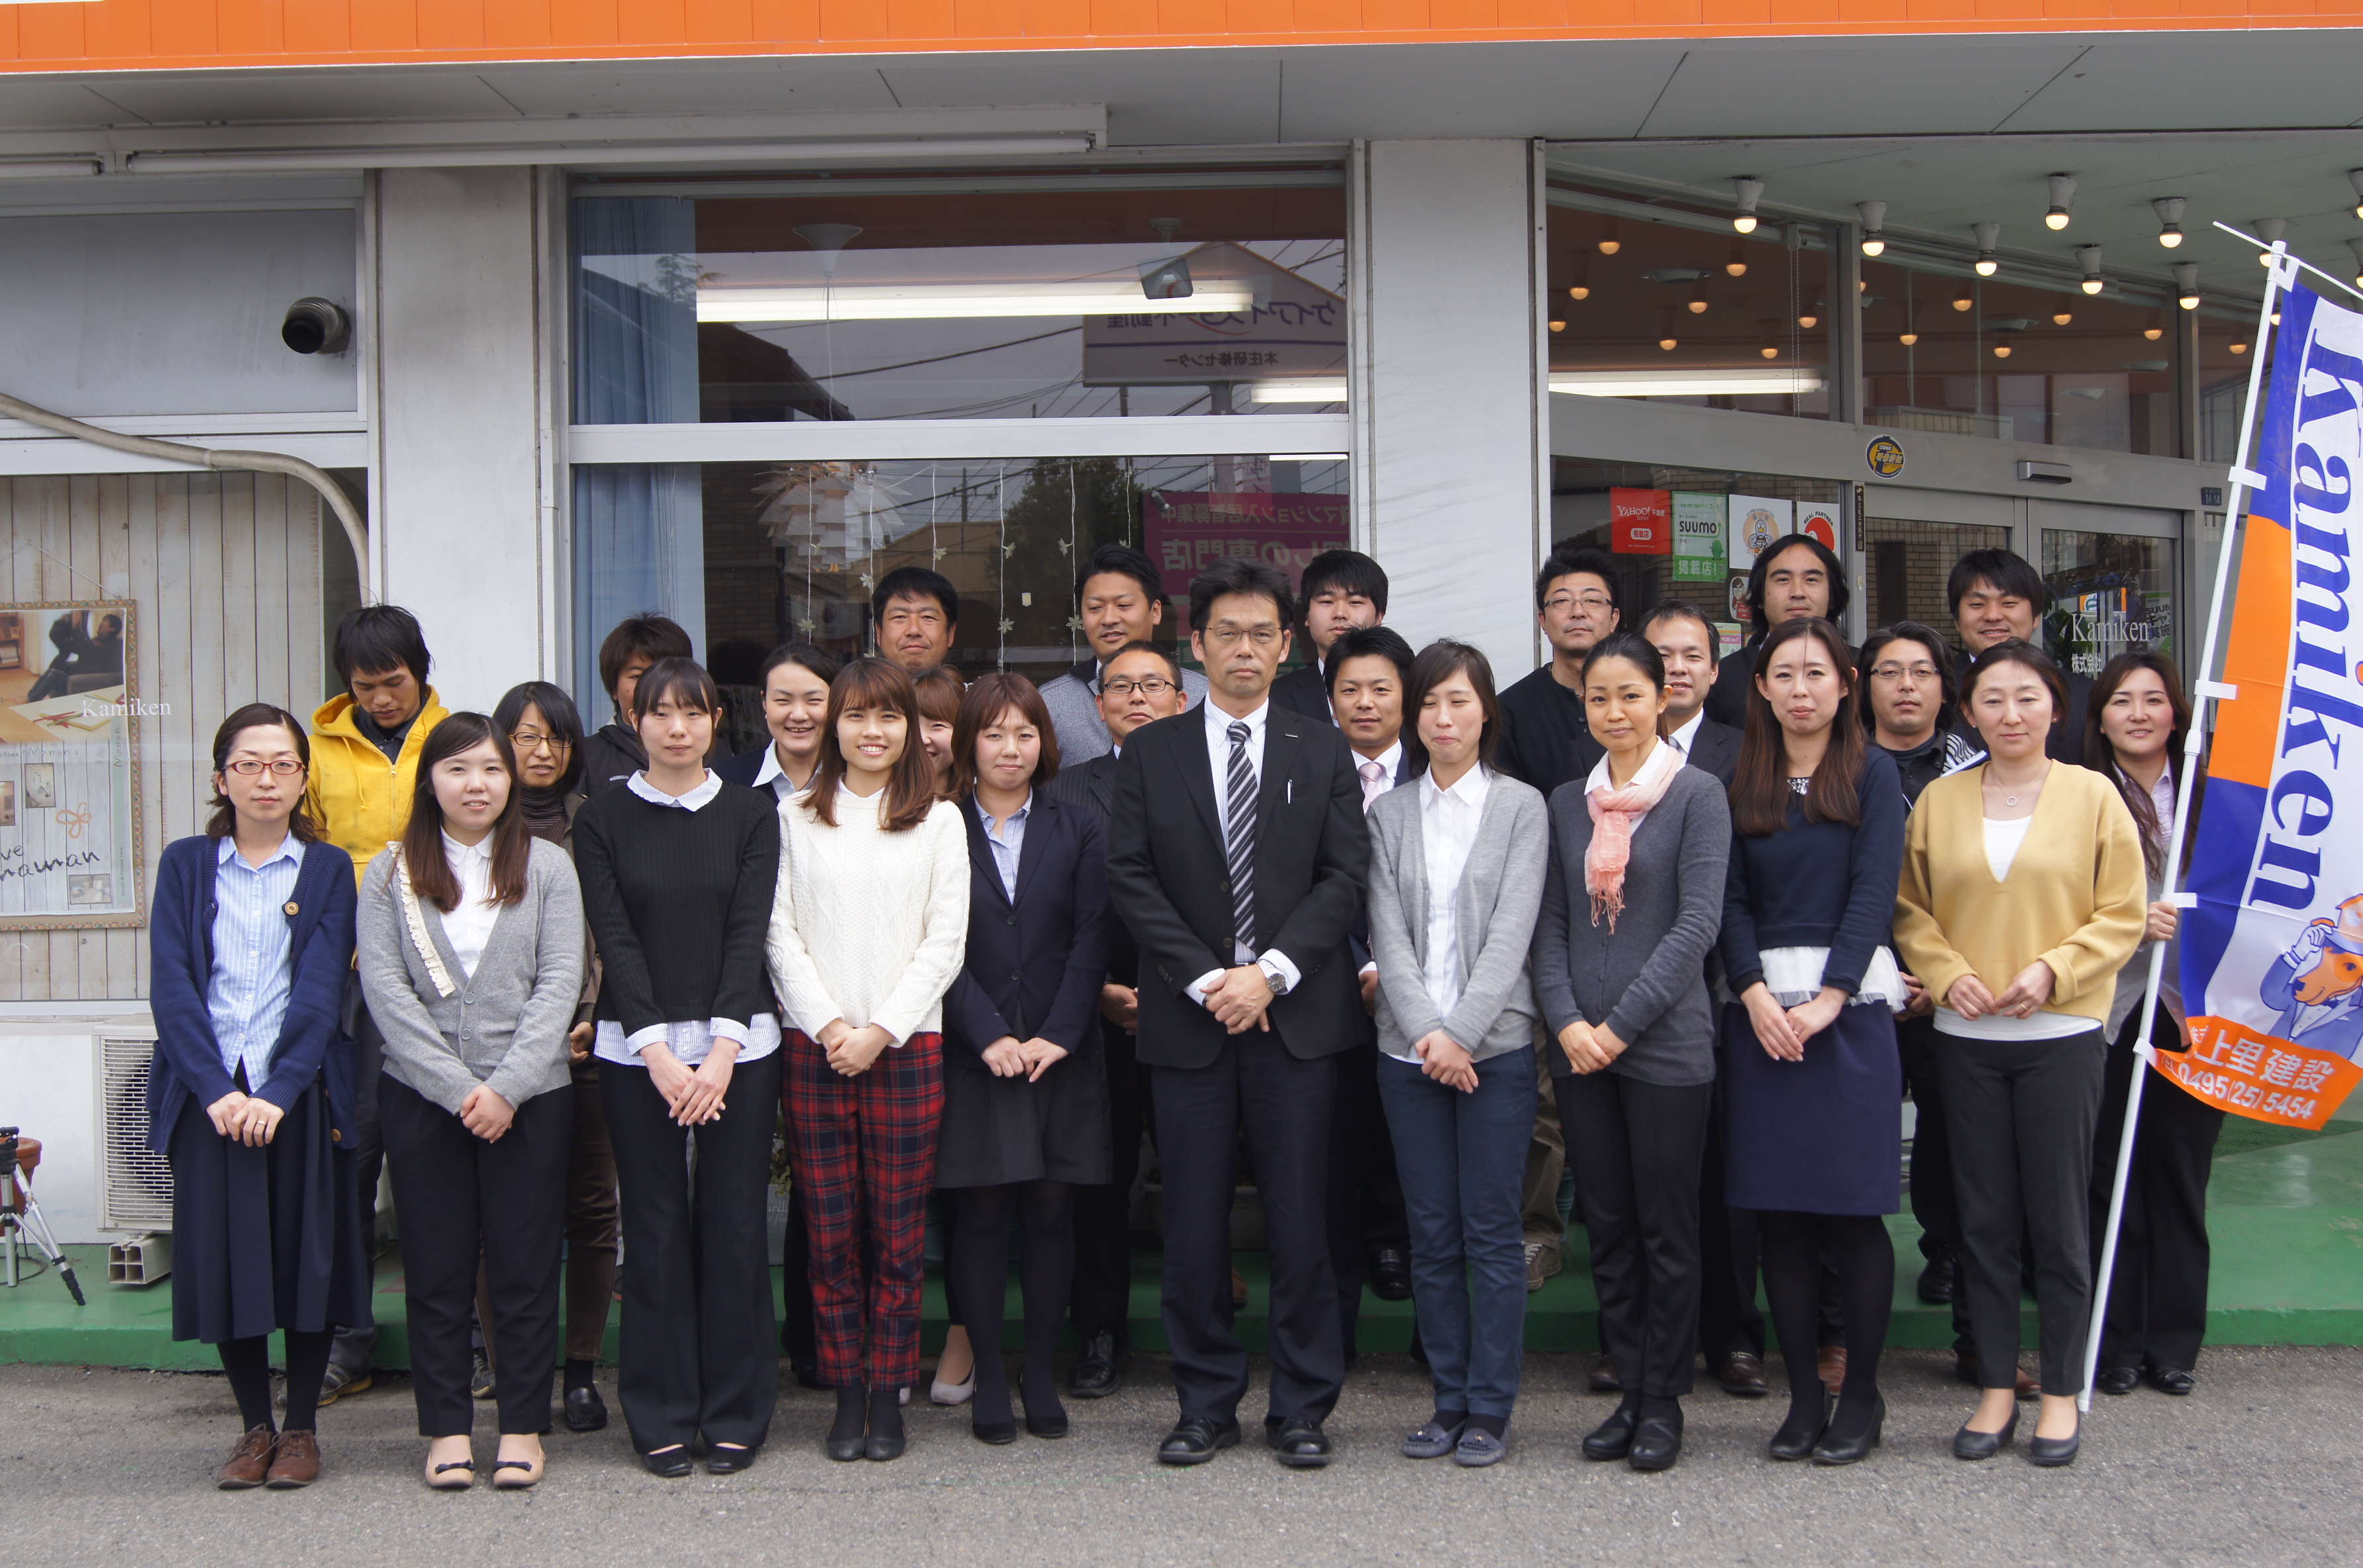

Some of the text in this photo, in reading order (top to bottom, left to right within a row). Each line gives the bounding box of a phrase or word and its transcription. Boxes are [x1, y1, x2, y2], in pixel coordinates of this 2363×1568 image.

[2071, 613, 2150, 642] Kamiken
[81, 698, 172, 717] Kamiken
[2194, 1028, 2335, 1093] 上里建設
